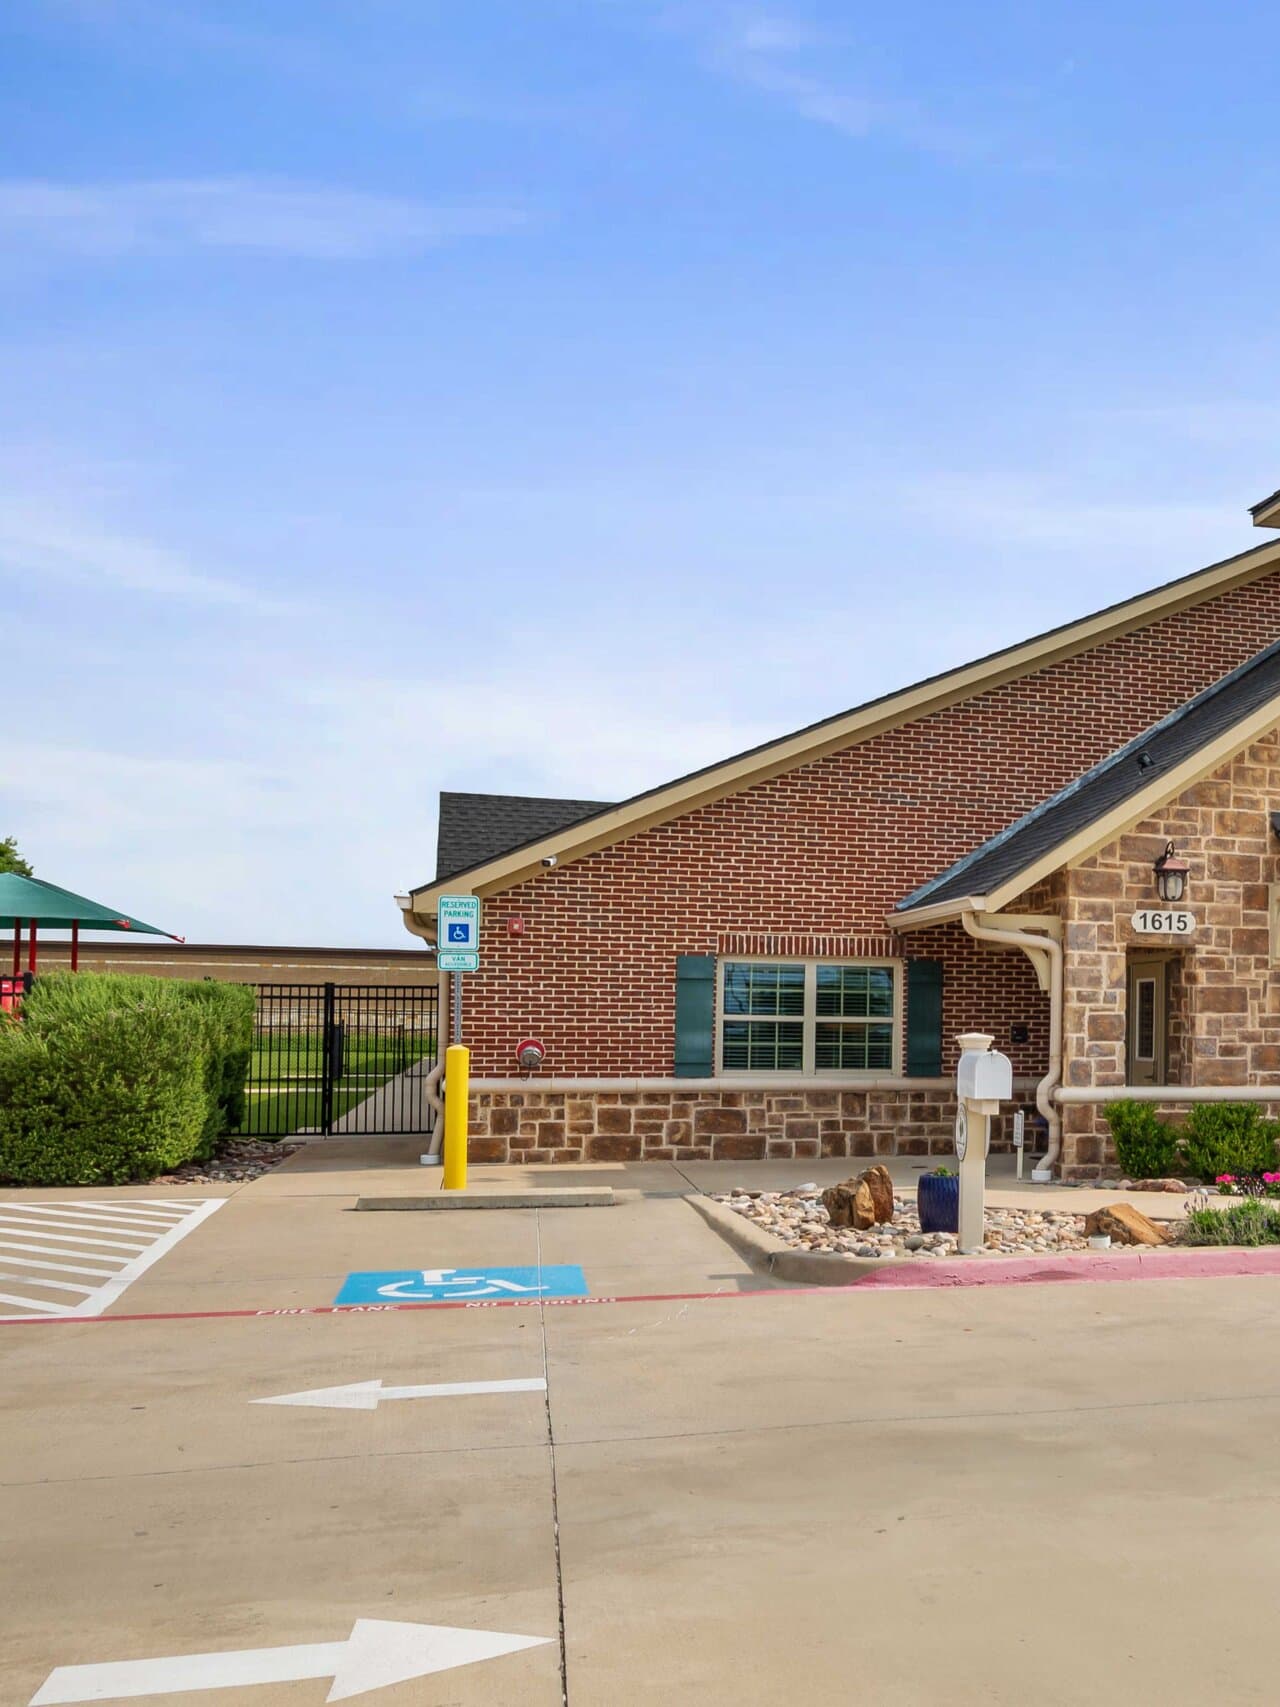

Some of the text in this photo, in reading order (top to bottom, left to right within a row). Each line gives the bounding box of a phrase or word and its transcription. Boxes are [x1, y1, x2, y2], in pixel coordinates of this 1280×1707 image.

[441, 901, 477, 909] RESERVED
[444, 910, 475, 918] PARKING
[1139, 912, 1188, 932] 1615
[256, 1308, 314, 1316] FIRE
[331, 1304, 400, 1313] LANE
[514, 1298, 618, 1306] PARKING
